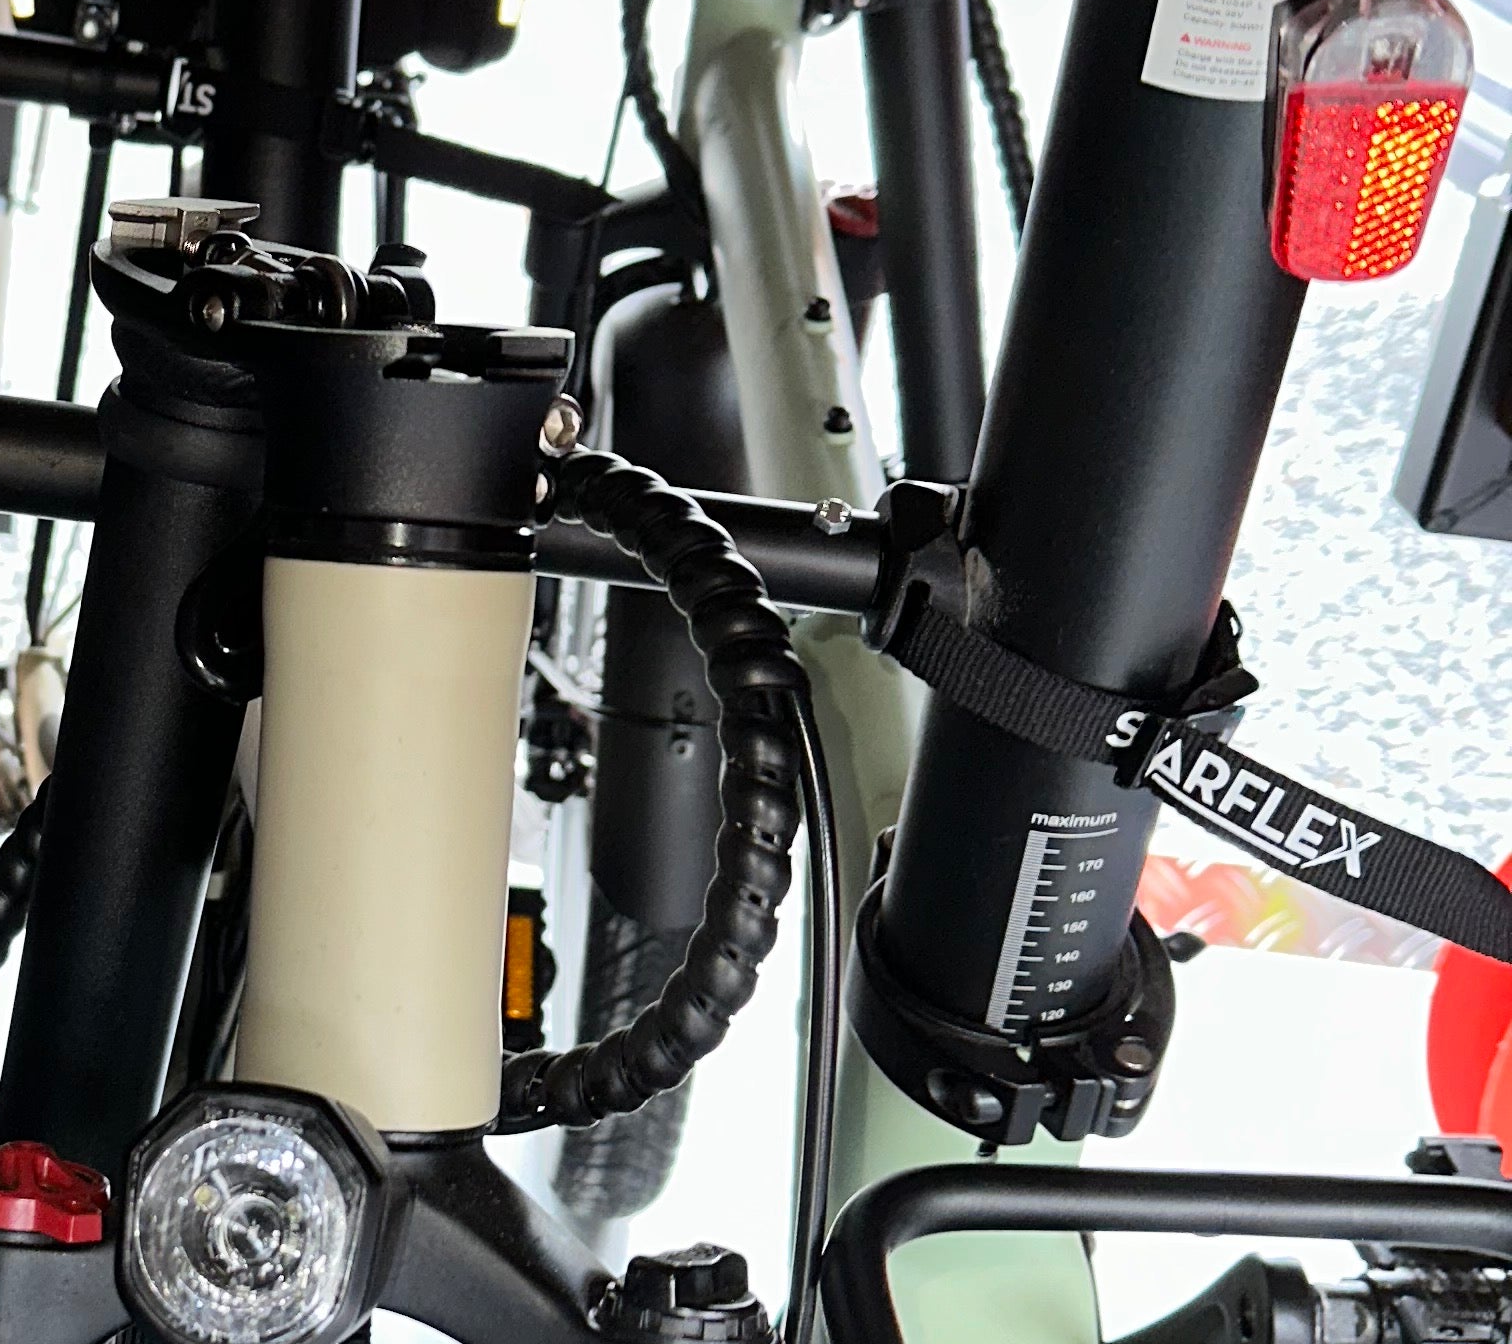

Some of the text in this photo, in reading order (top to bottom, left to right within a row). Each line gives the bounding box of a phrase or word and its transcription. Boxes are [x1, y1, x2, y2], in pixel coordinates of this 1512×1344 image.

[1193, 36, 1252, 52] WARNING
[1105, 710, 1383, 878] SARFLEX
[1030, 812, 1118, 828] maximum
[1078, 858, 1104, 873] 170
[1070, 889, 1096, 903] 160
[1054, 950, 1080, 964] 140
[1047, 979, 1073, 993] 130
[1040, 1008, 1066, 1022] 120
